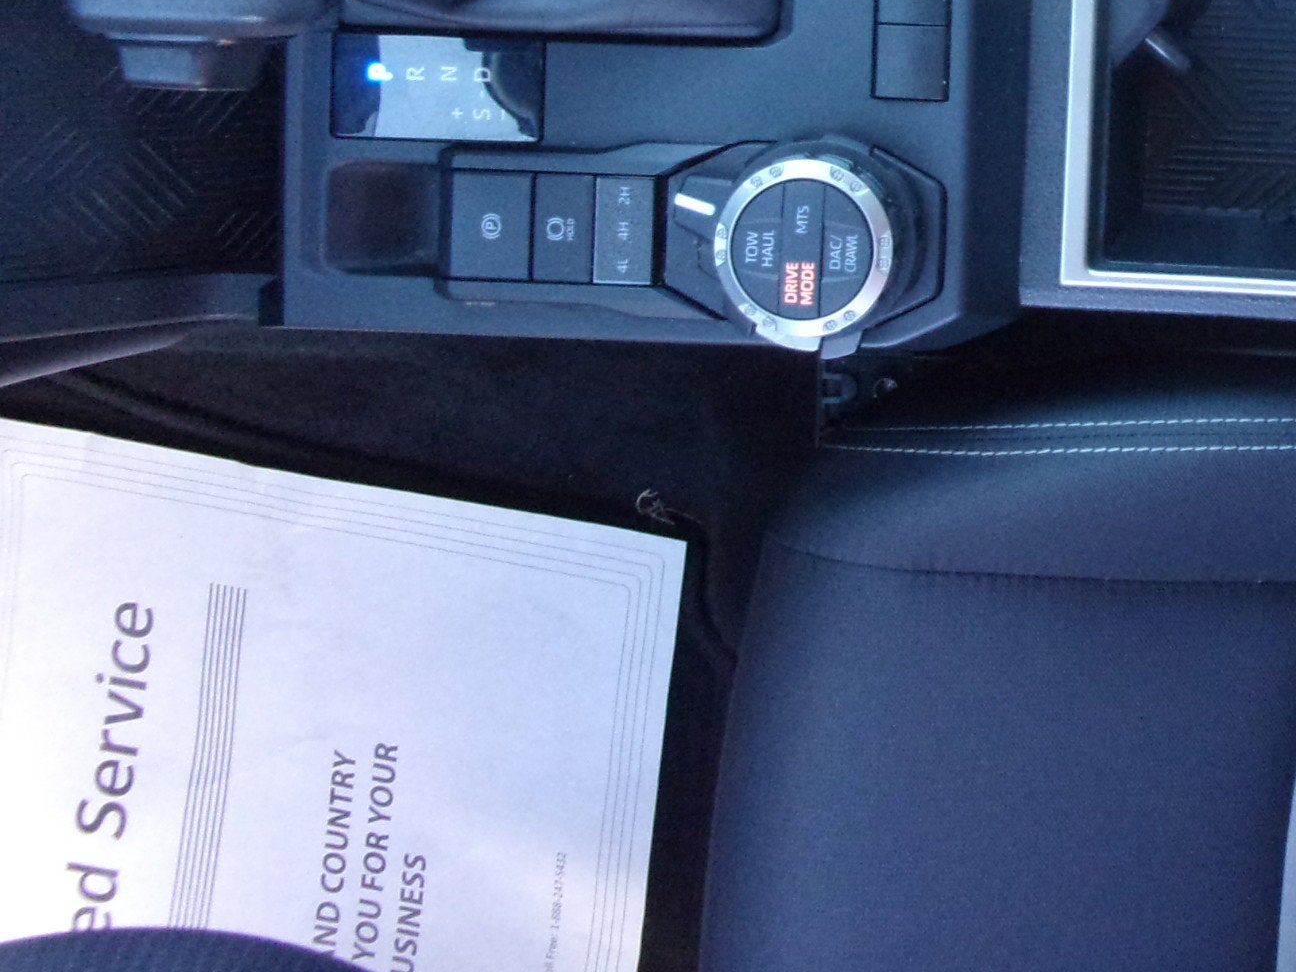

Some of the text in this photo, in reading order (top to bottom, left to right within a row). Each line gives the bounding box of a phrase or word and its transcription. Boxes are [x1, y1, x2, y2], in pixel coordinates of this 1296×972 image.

[366, 62, 394, 82] P
[405, 66, 426, 81] R
[440, 65, 458, 81] N
[473, 66, 491, 82] D
[471, 108, 491, 121] S
[618, 186, 631, 206] 2H
[566, 217, 575, 241] HOLD
[617, 221, 630, 241] 4H
[795, 204, 810, 235] MTS
[744, 231, 759, 264] TOW
[761, 229, 775, 268] HAUL
[828, 234, 843, 271] DAC/
[843, 234, 859, 273] CRAWL
[783, 261, 799, 305] DRIVE
[799, 261, 816, 306] MODE
[74, 600, 155, 841] Service
[319, 749, 357, 895] COUNTRY
[351, 742, 399, 961] YOU FOR YOUR
